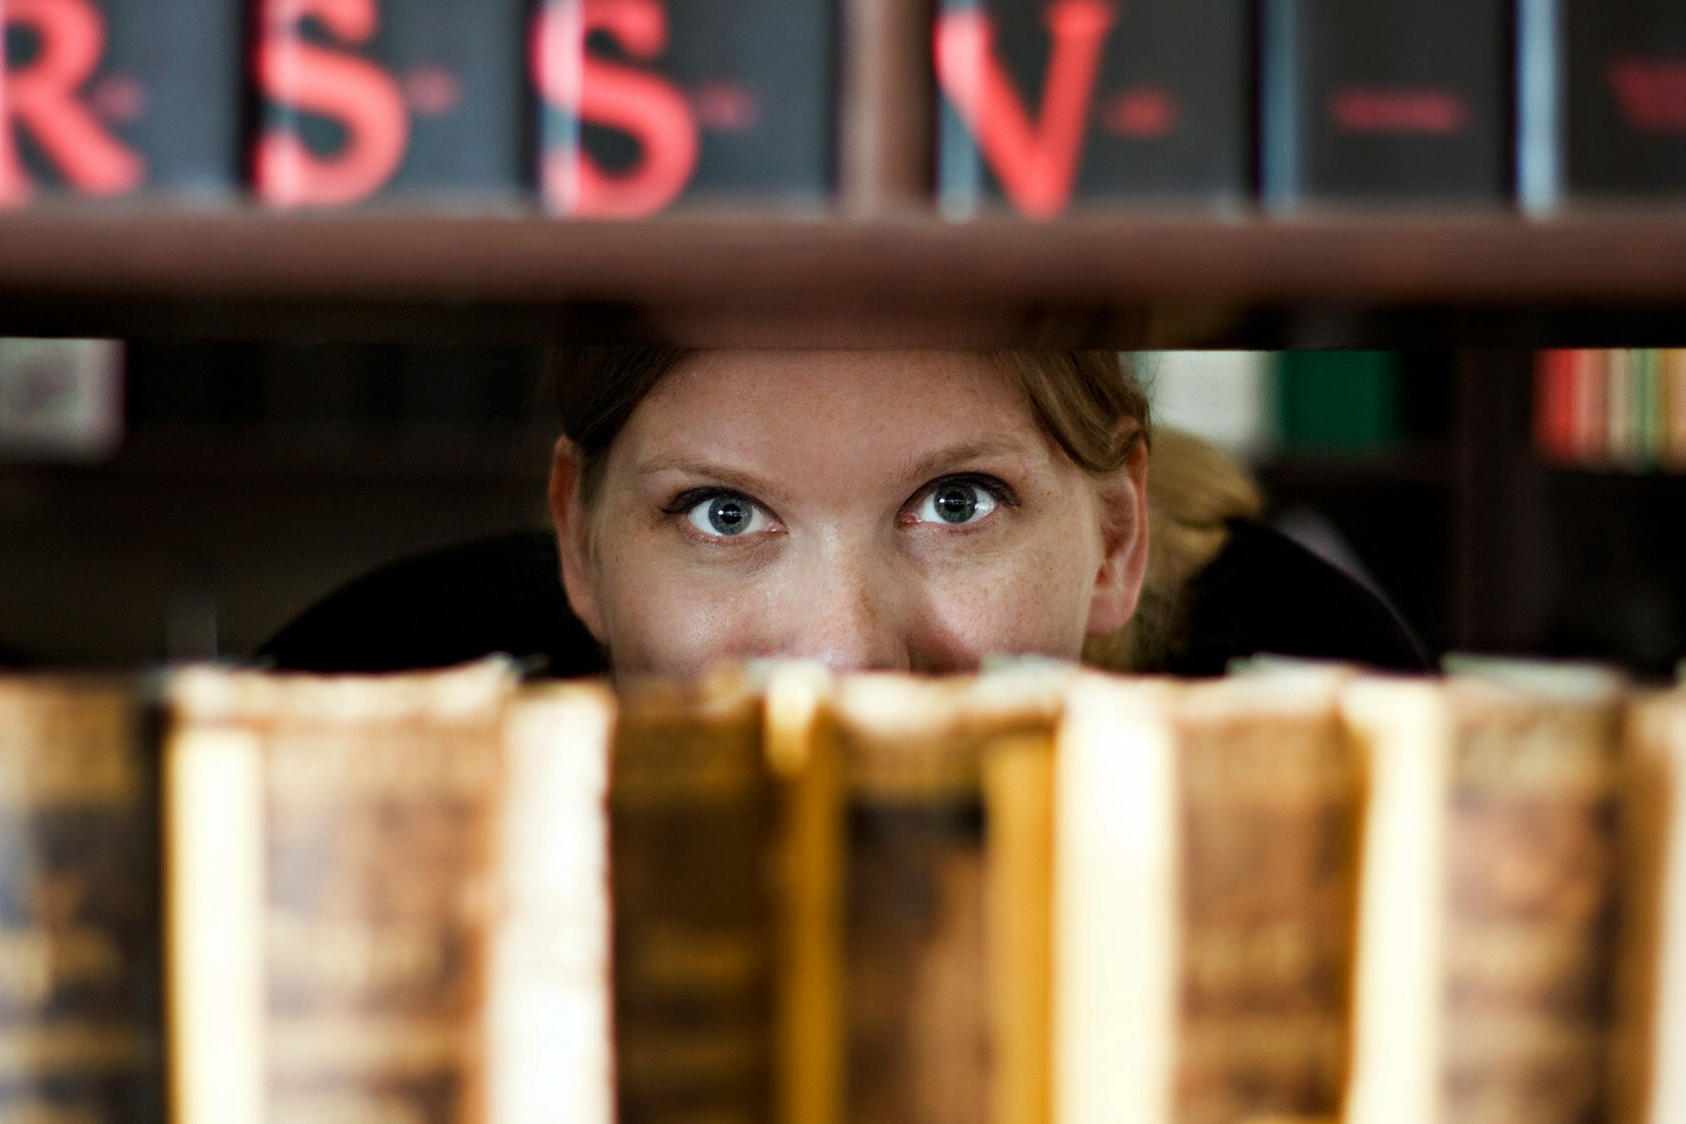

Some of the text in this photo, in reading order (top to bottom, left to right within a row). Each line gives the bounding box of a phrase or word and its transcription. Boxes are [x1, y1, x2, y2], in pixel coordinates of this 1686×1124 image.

[260, 0, 410, 206] S
[533, 0, 700, 218] S
[934, 0, 1114, 216] V
